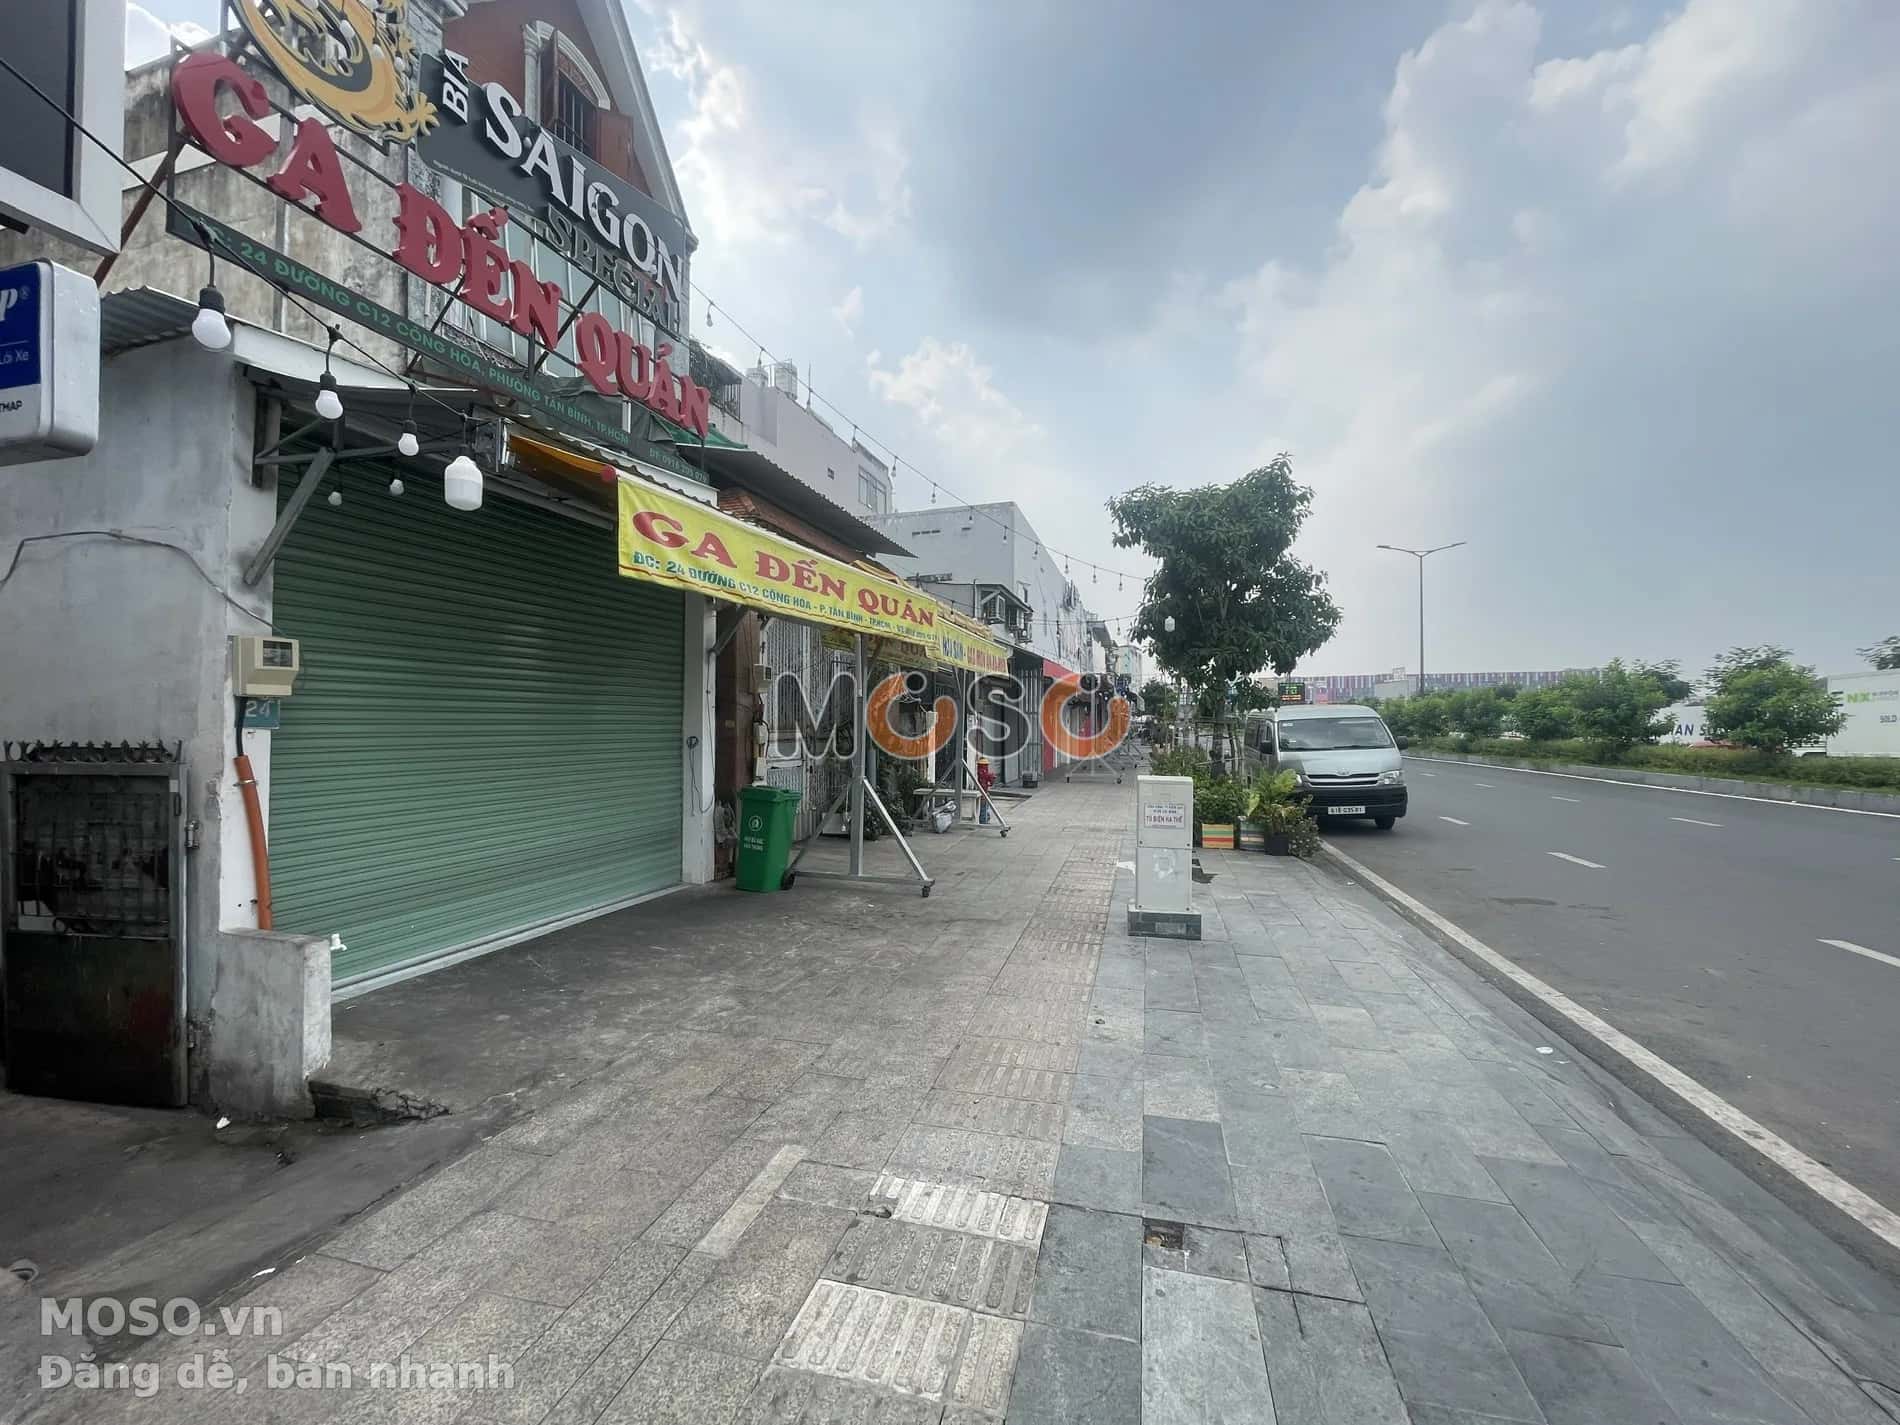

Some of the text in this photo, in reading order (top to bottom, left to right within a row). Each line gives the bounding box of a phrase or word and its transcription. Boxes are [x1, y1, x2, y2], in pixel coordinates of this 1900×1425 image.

[442, 49, 469, 124] BIA
[485, 82, 686, 301] SAIGON
[239, 243, 269, 268] 24
[355, 302, 392, 328] C12
[632, 511, 737, 569] GA
[857, 588, 934, 627] QUÁN
[633, 551, 660, 570] ĐC:
[738, 580, 760, 596] C12
[246, 700, 271, 718] 24
